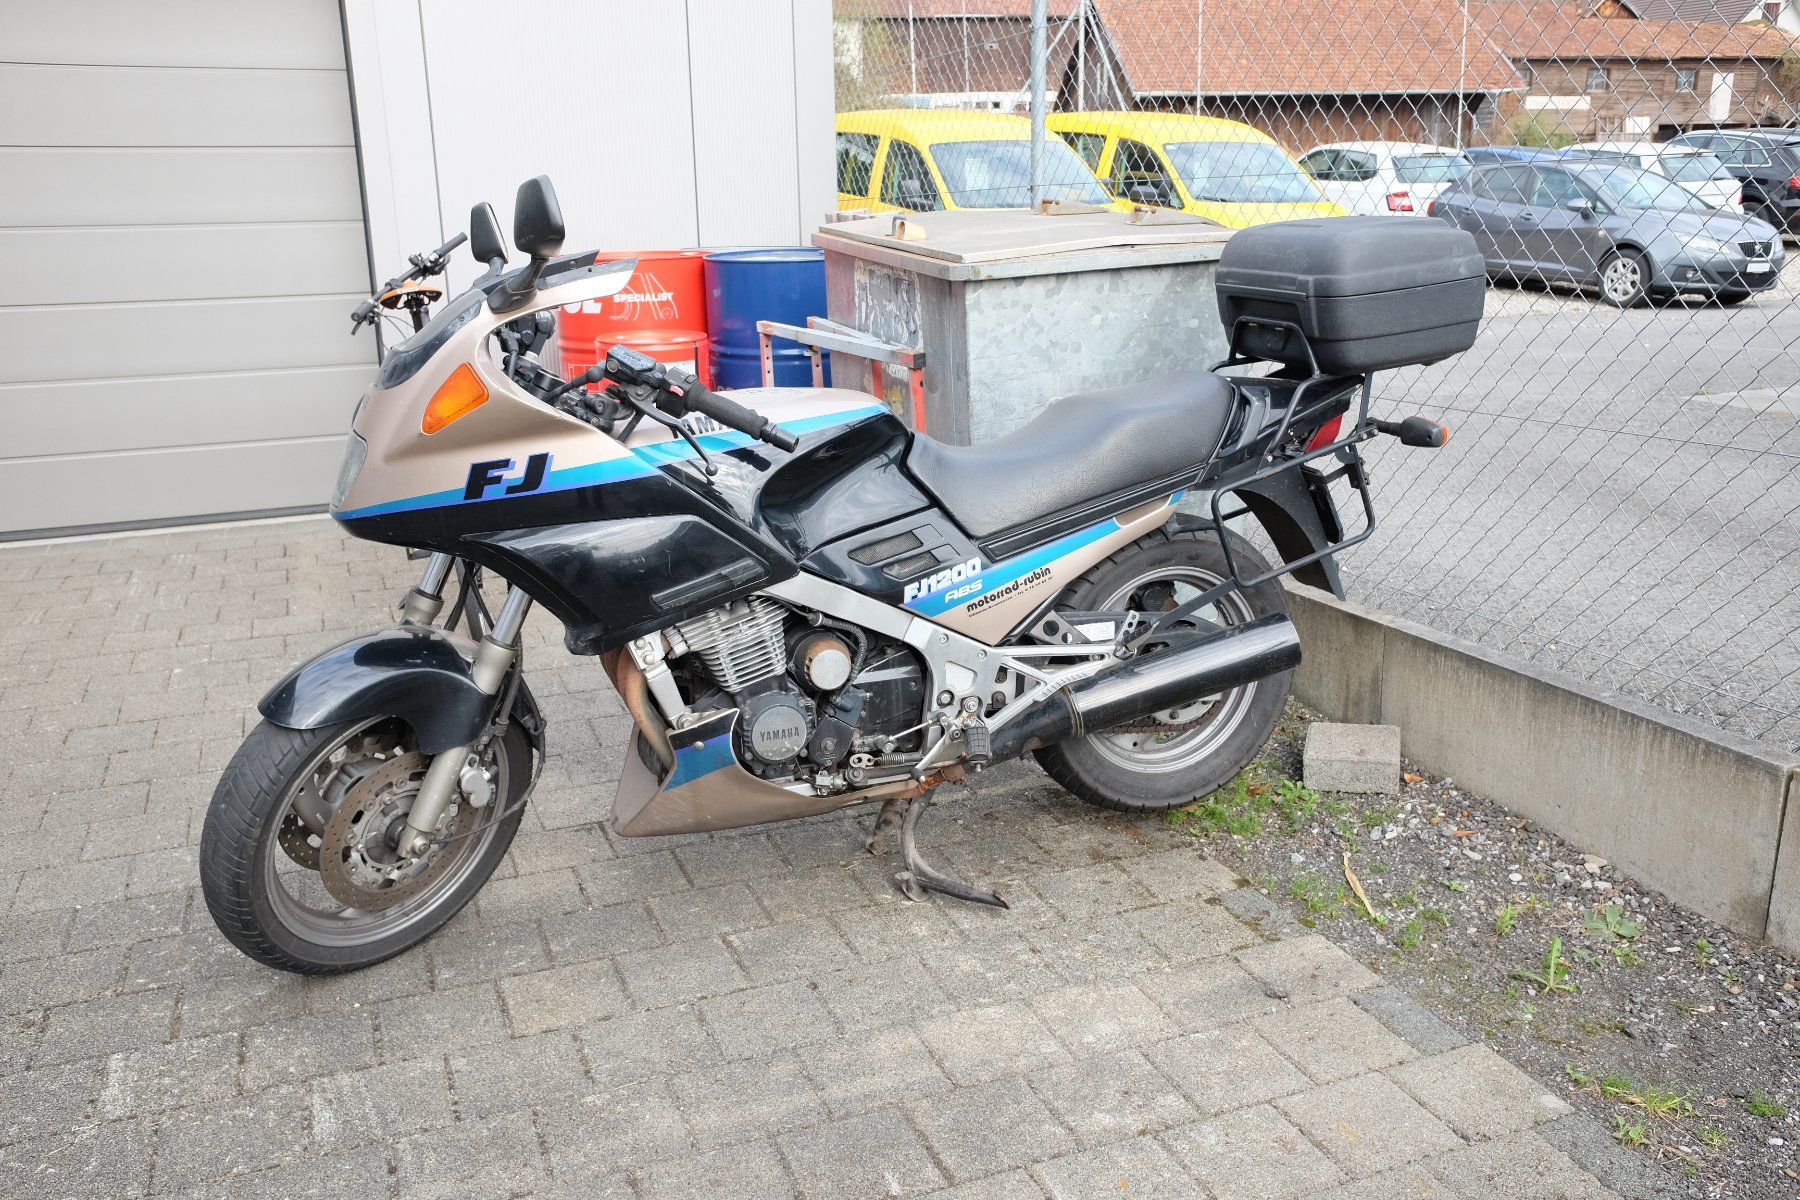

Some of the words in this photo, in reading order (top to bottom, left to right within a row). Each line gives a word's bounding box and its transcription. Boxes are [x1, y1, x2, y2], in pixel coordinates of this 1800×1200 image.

[613, 292, 674, 303] SPECIALIST
[463, 452, 554, 501] FJ
[904, 557, 982, 604] FJ1200
[944, 579, 983, 604] ABS
[966, 566, 1052, 613] motorrad-rubin
[760, 727, 800, 742] YAMAHA
